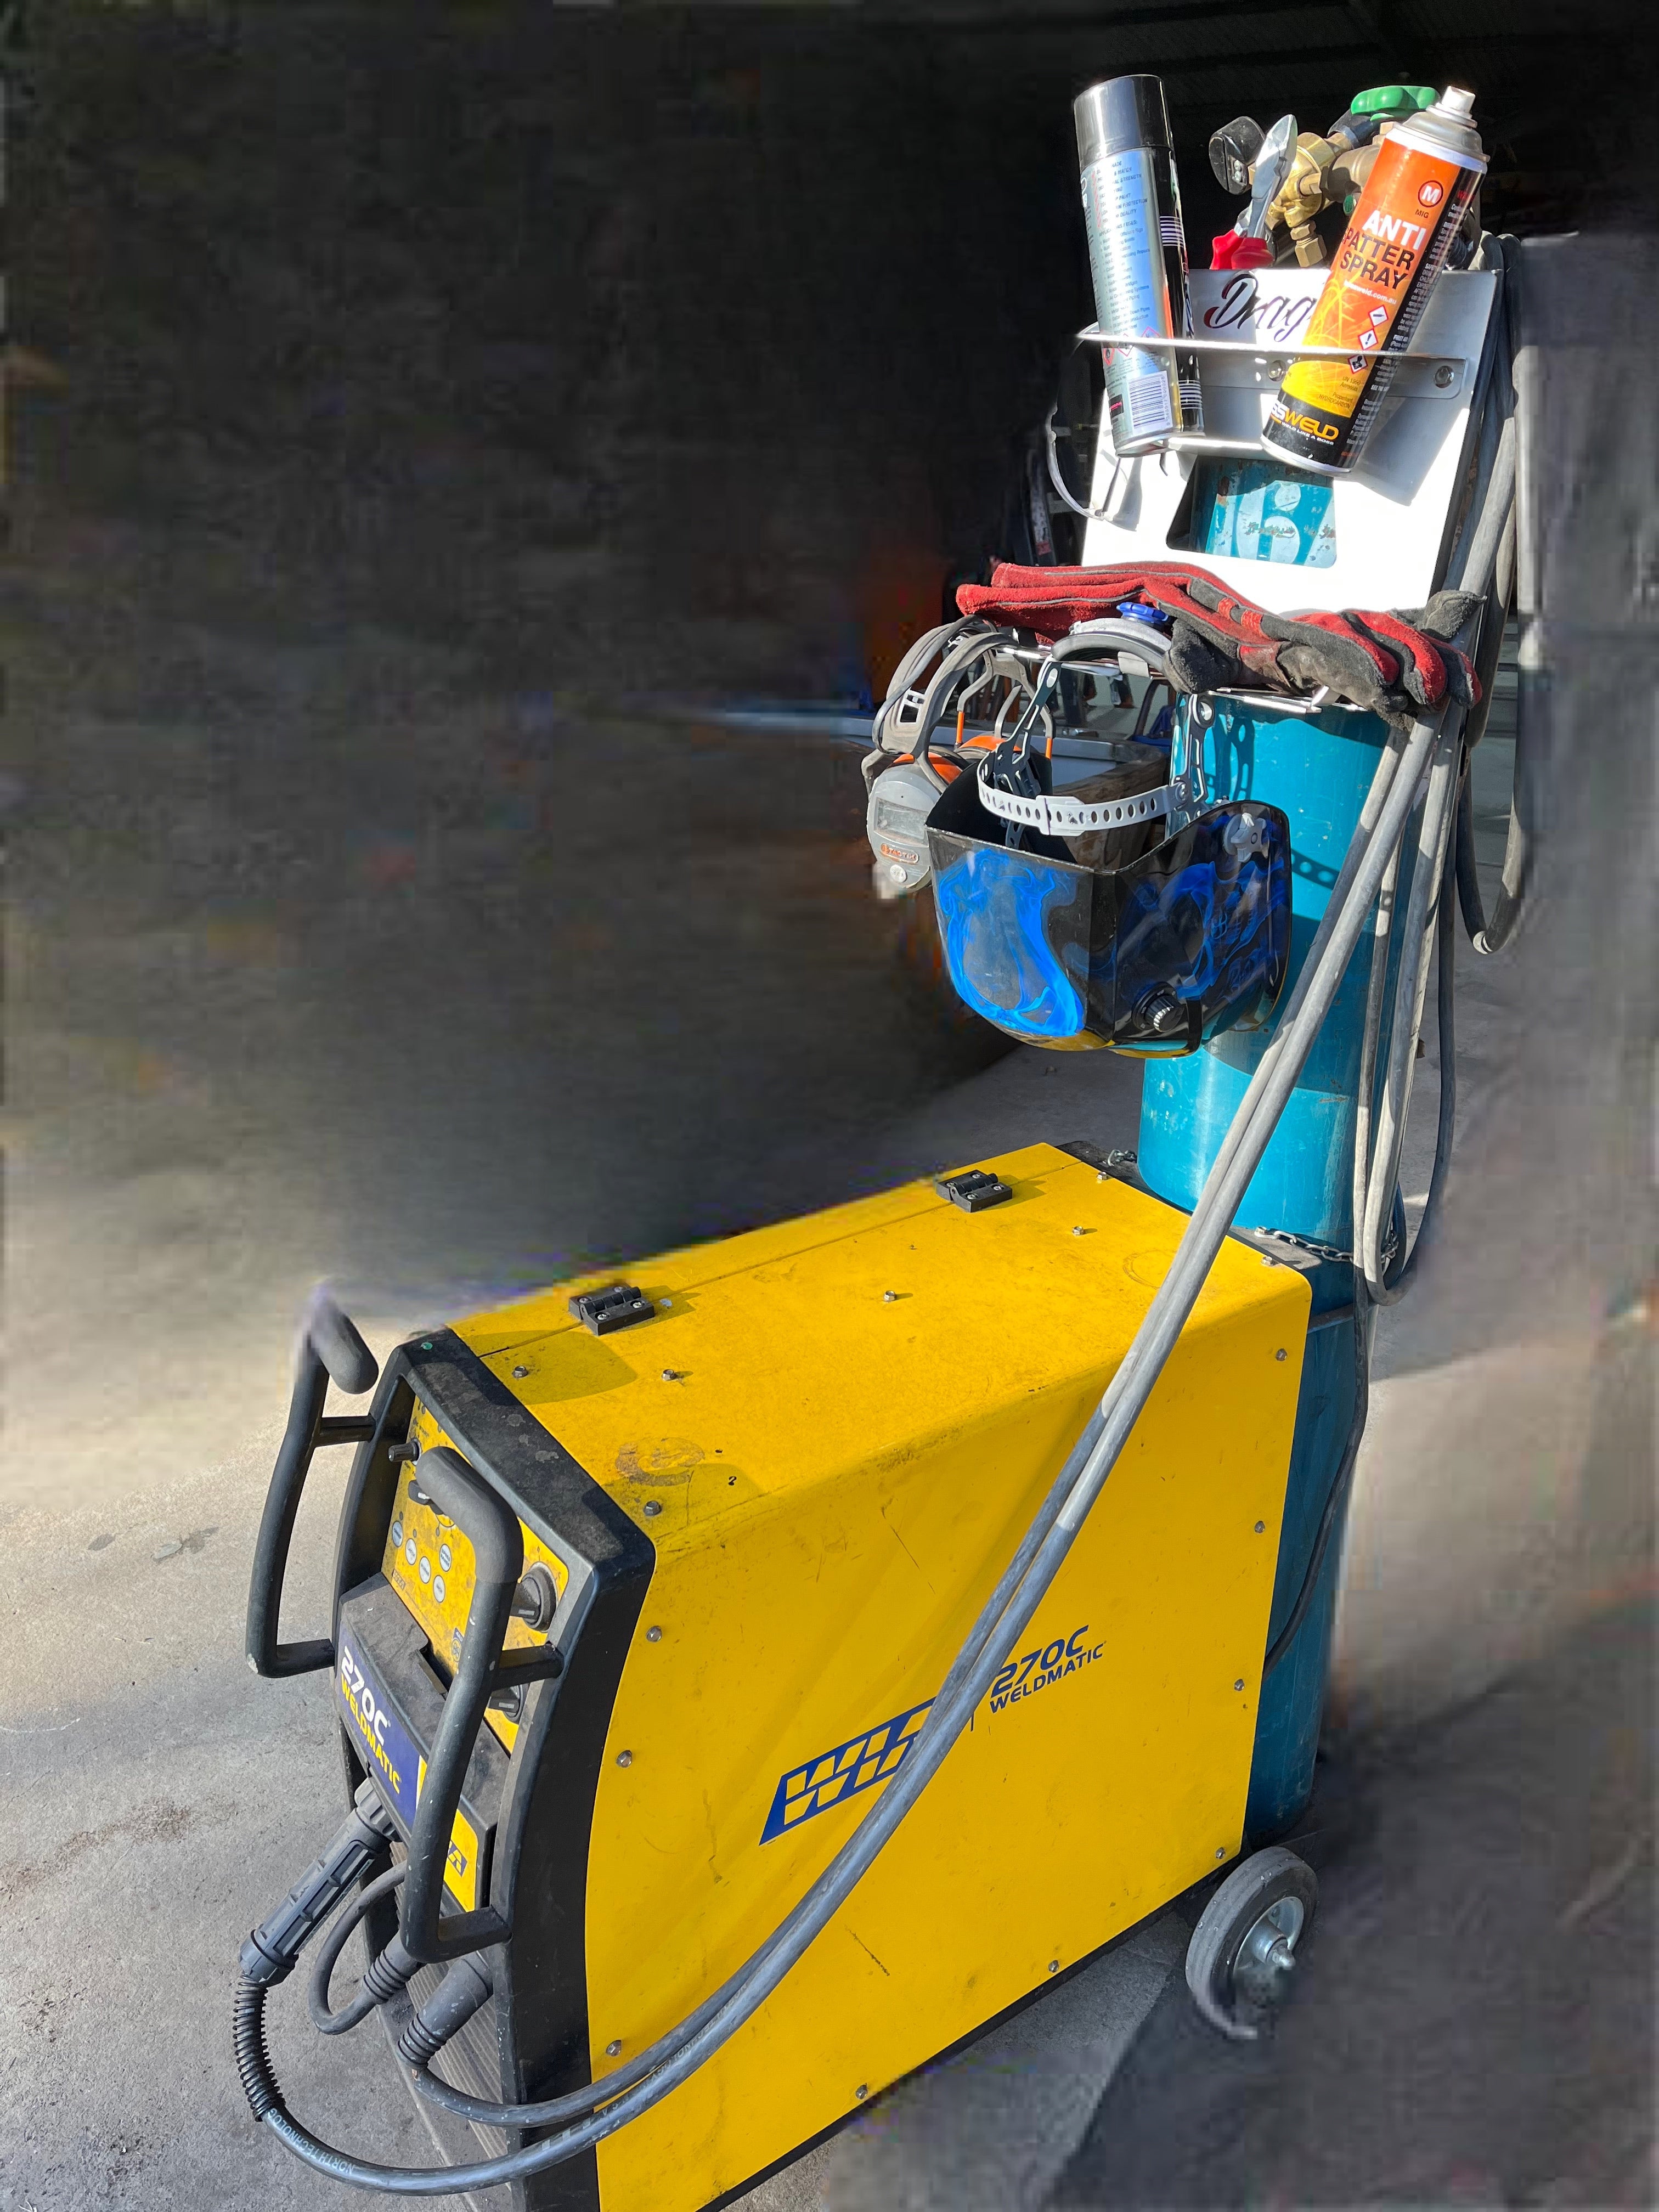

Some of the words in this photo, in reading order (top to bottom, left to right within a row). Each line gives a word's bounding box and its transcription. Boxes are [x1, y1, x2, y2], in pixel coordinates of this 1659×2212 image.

[1415, 208, 1430, 219] MIG
[1421, 185, 1440, 204] M
[1362, 210, 1426, 250] ANTI
[1340, 250, 1408, 290] SPRAY
[1203, 270, 1318, 342] Drag
[1282, 421, 1296, 431] WELD
[1296, 428, 1310, 437] LIKE
[990, 1625, 1089, 1699] 270C
[990, 1643, 1104, 1714] WELDMATIC
[341, 1646, 388, 1746] 270C
[341, 1672, 400, 1794] WELDMATIC
[267, 2108, 319, 2159] TECHNOLOG
[318, 2151, 356, 2175] NORTH
